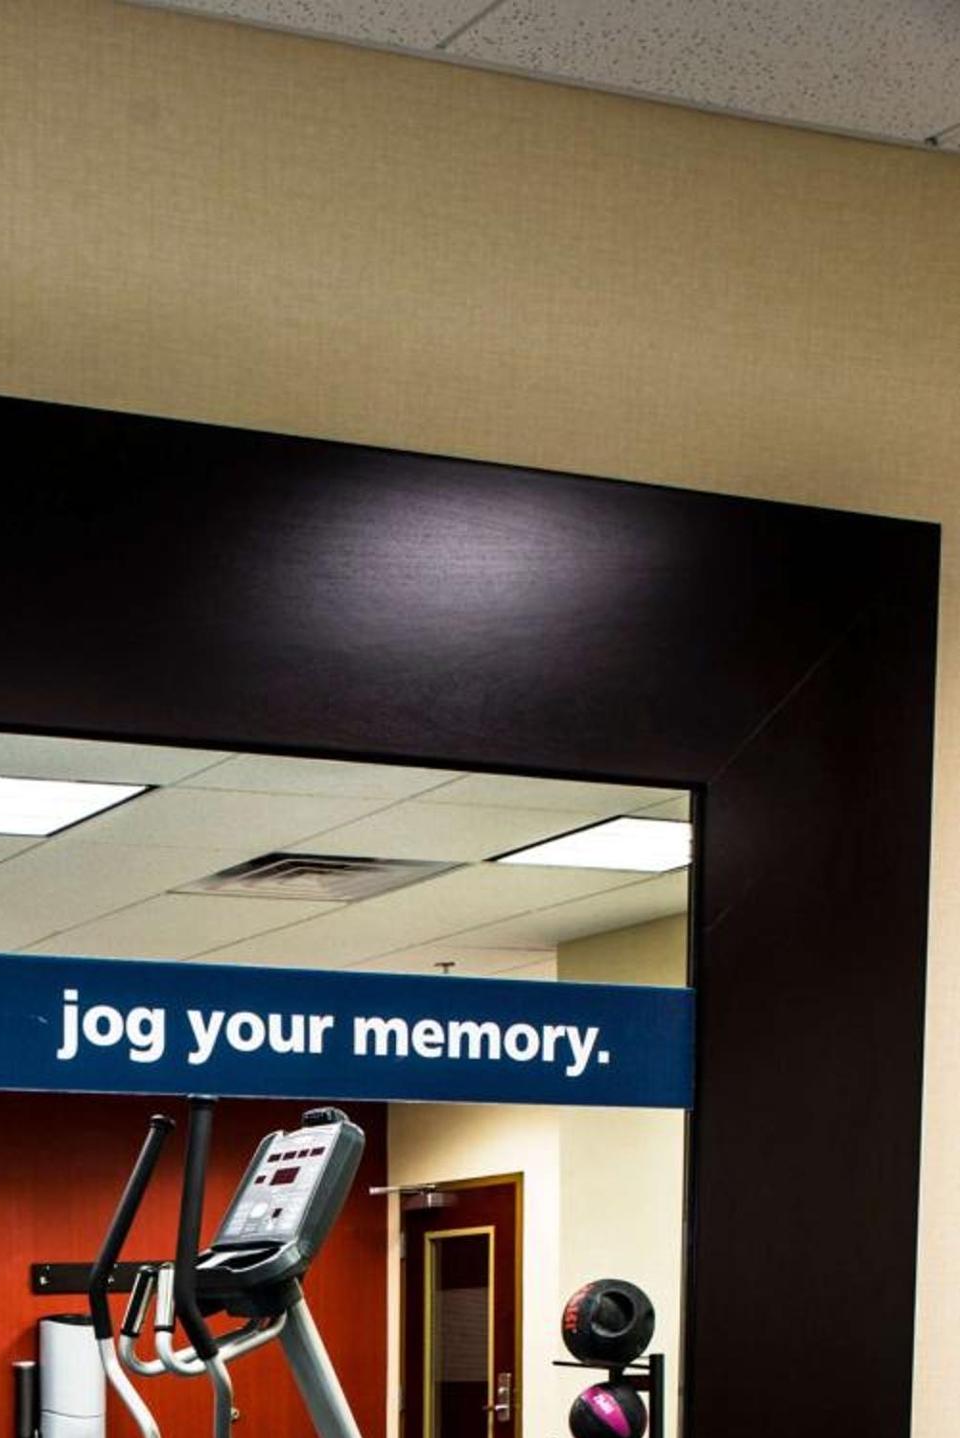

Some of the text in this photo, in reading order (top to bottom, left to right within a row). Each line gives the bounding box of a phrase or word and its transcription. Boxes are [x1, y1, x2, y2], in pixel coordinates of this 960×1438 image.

[57, 989, 609, 1076] jog your memory.
